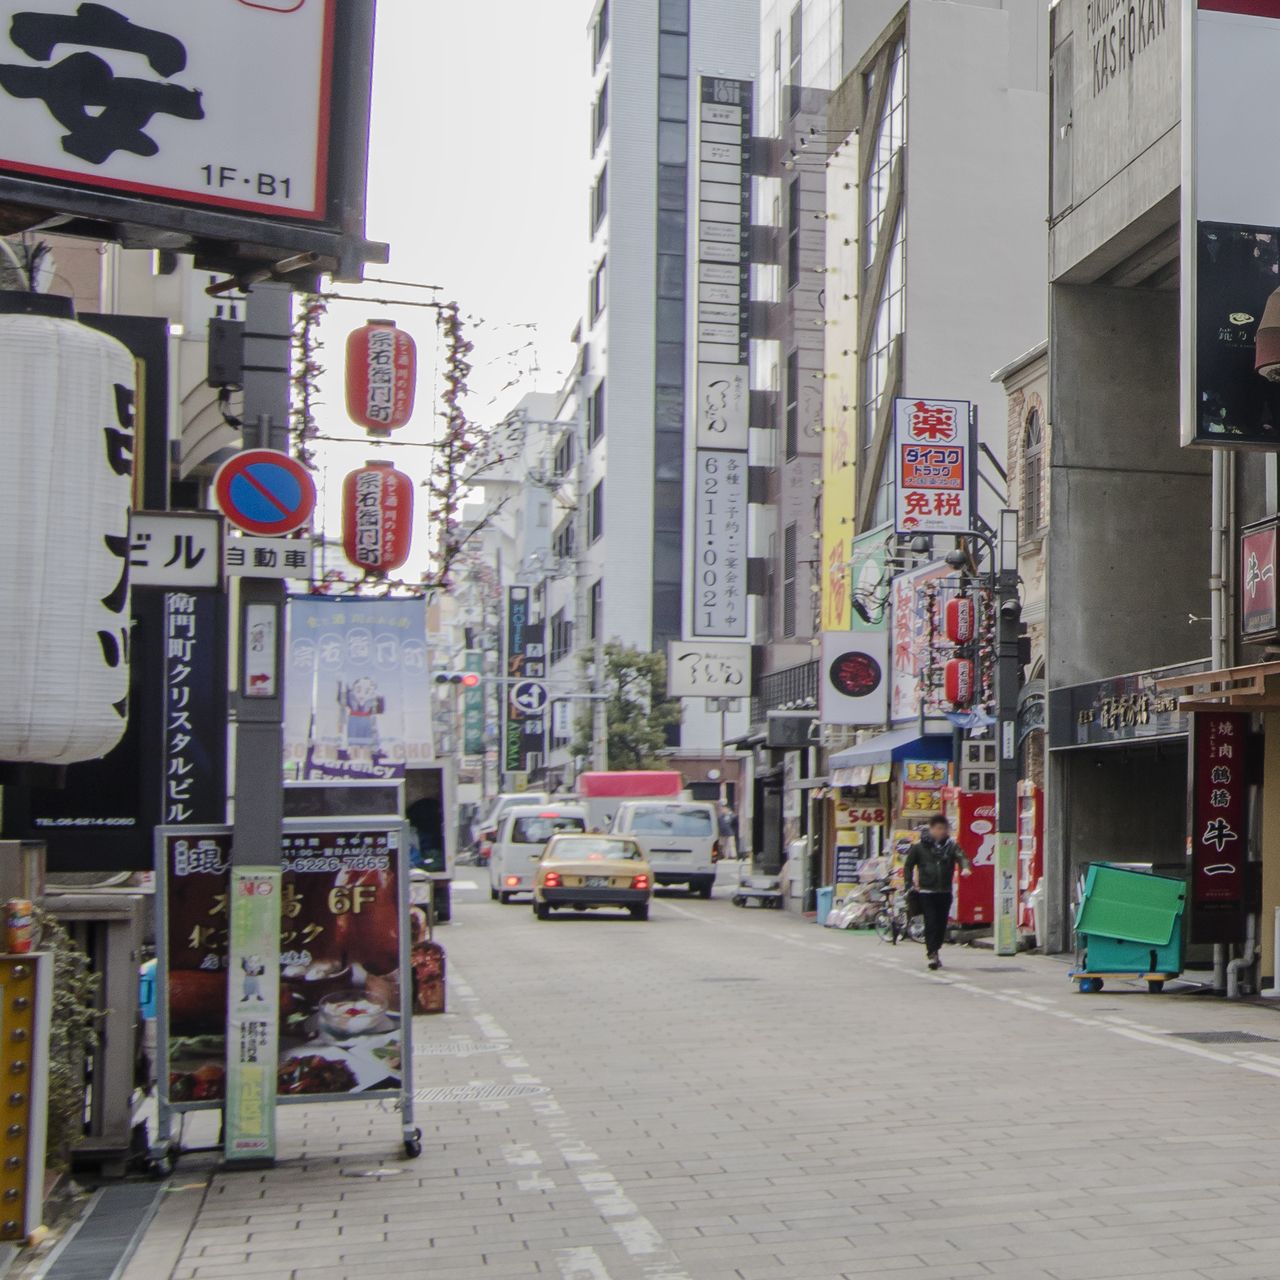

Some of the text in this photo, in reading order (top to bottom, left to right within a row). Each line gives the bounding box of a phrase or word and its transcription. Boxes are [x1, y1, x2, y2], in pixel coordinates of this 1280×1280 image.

[369, 331, 392, 422] 宗右衛門町
[911, 401, 954, 440] 薬
[906, 448, 960, 465] ダイコク
[904, 490, 962, 517] 免税
[358, 473, 380, 564] 宗右衛門町
[227, 547, 308, 569] 自動車
[1246, 552, 1274, 599] 牛一
[849, 807, 885, 824] 548
[328, 886, 376, 915] 6F
